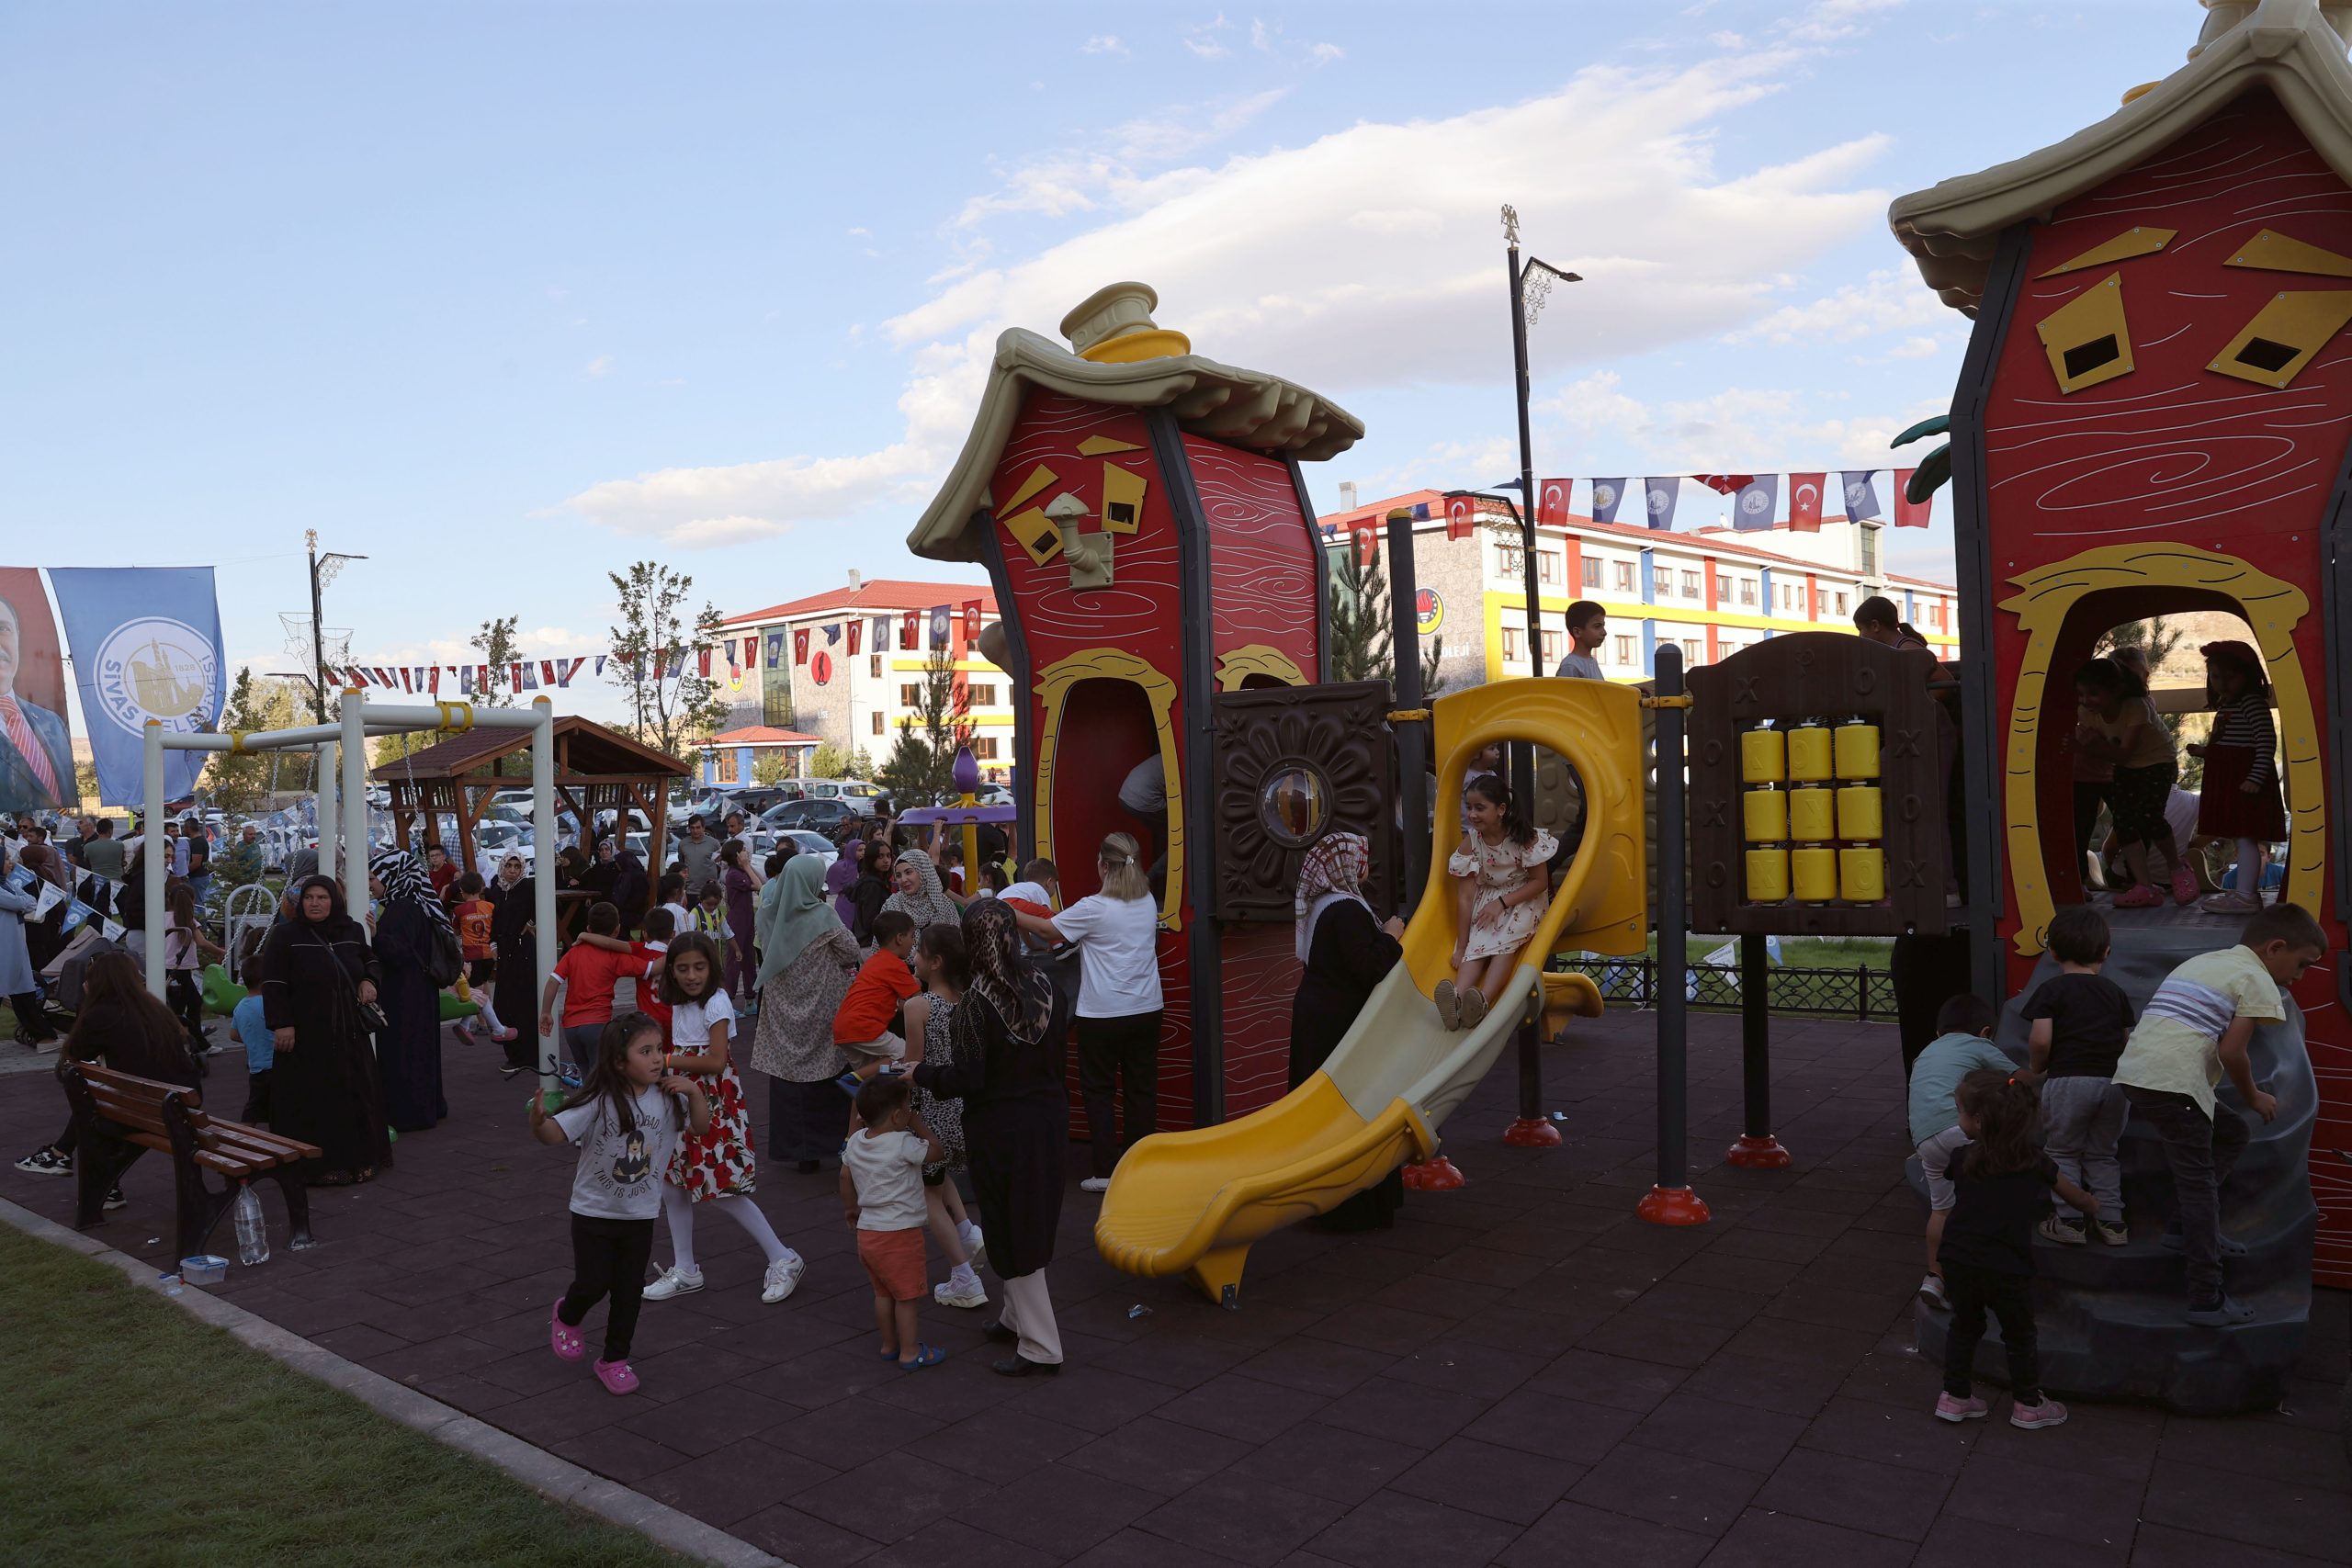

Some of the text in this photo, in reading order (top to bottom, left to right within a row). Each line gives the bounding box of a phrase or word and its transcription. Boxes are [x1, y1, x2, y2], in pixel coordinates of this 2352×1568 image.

[1439, 642, 1470, 658] OLEJİ
[104, 660, 139, 720] SİVAS
[594, 1168, 614, 1190] THIS
[613, 1186, 626, 1199] IS
[628, 1179, 651, 1199] JUST
